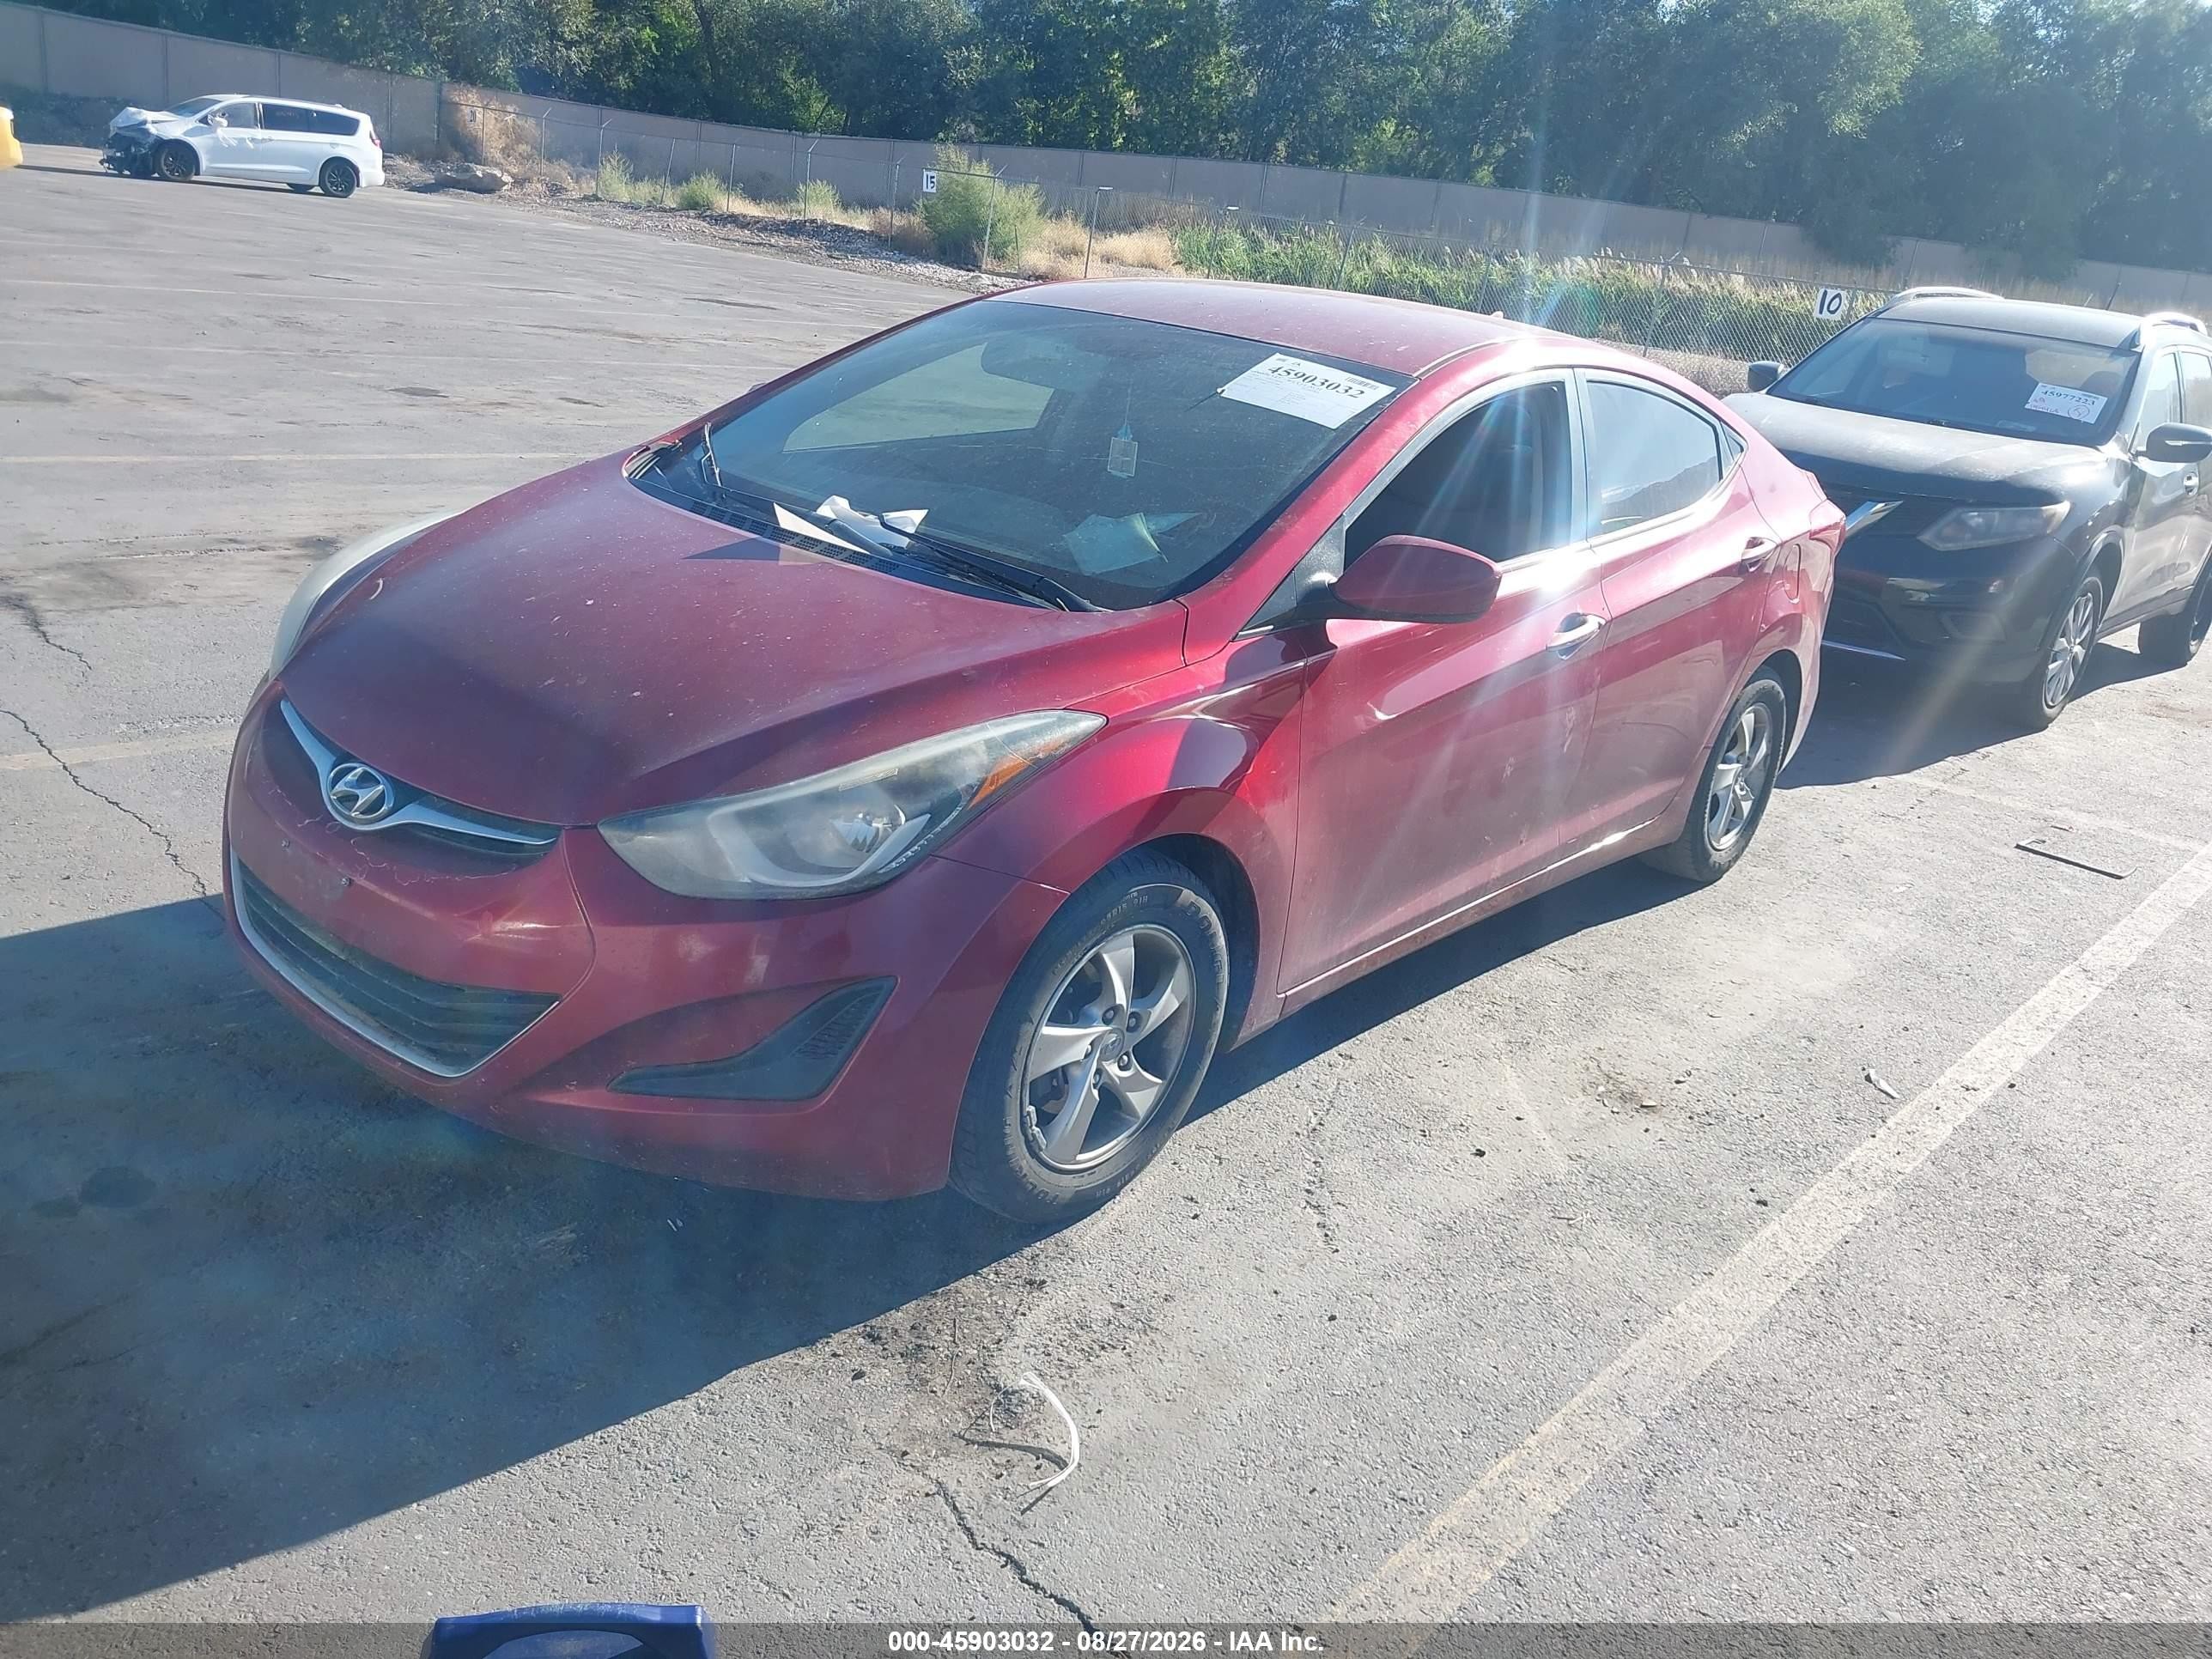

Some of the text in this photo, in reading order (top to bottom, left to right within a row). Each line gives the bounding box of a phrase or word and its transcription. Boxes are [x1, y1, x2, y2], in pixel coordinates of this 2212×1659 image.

[926, 174, 936, 190] 15
[1819, 289, 1843, 315] 10
[1267, 366, 1365, 398] 45903032
[2040, 389, 2096, 406] 45977223
